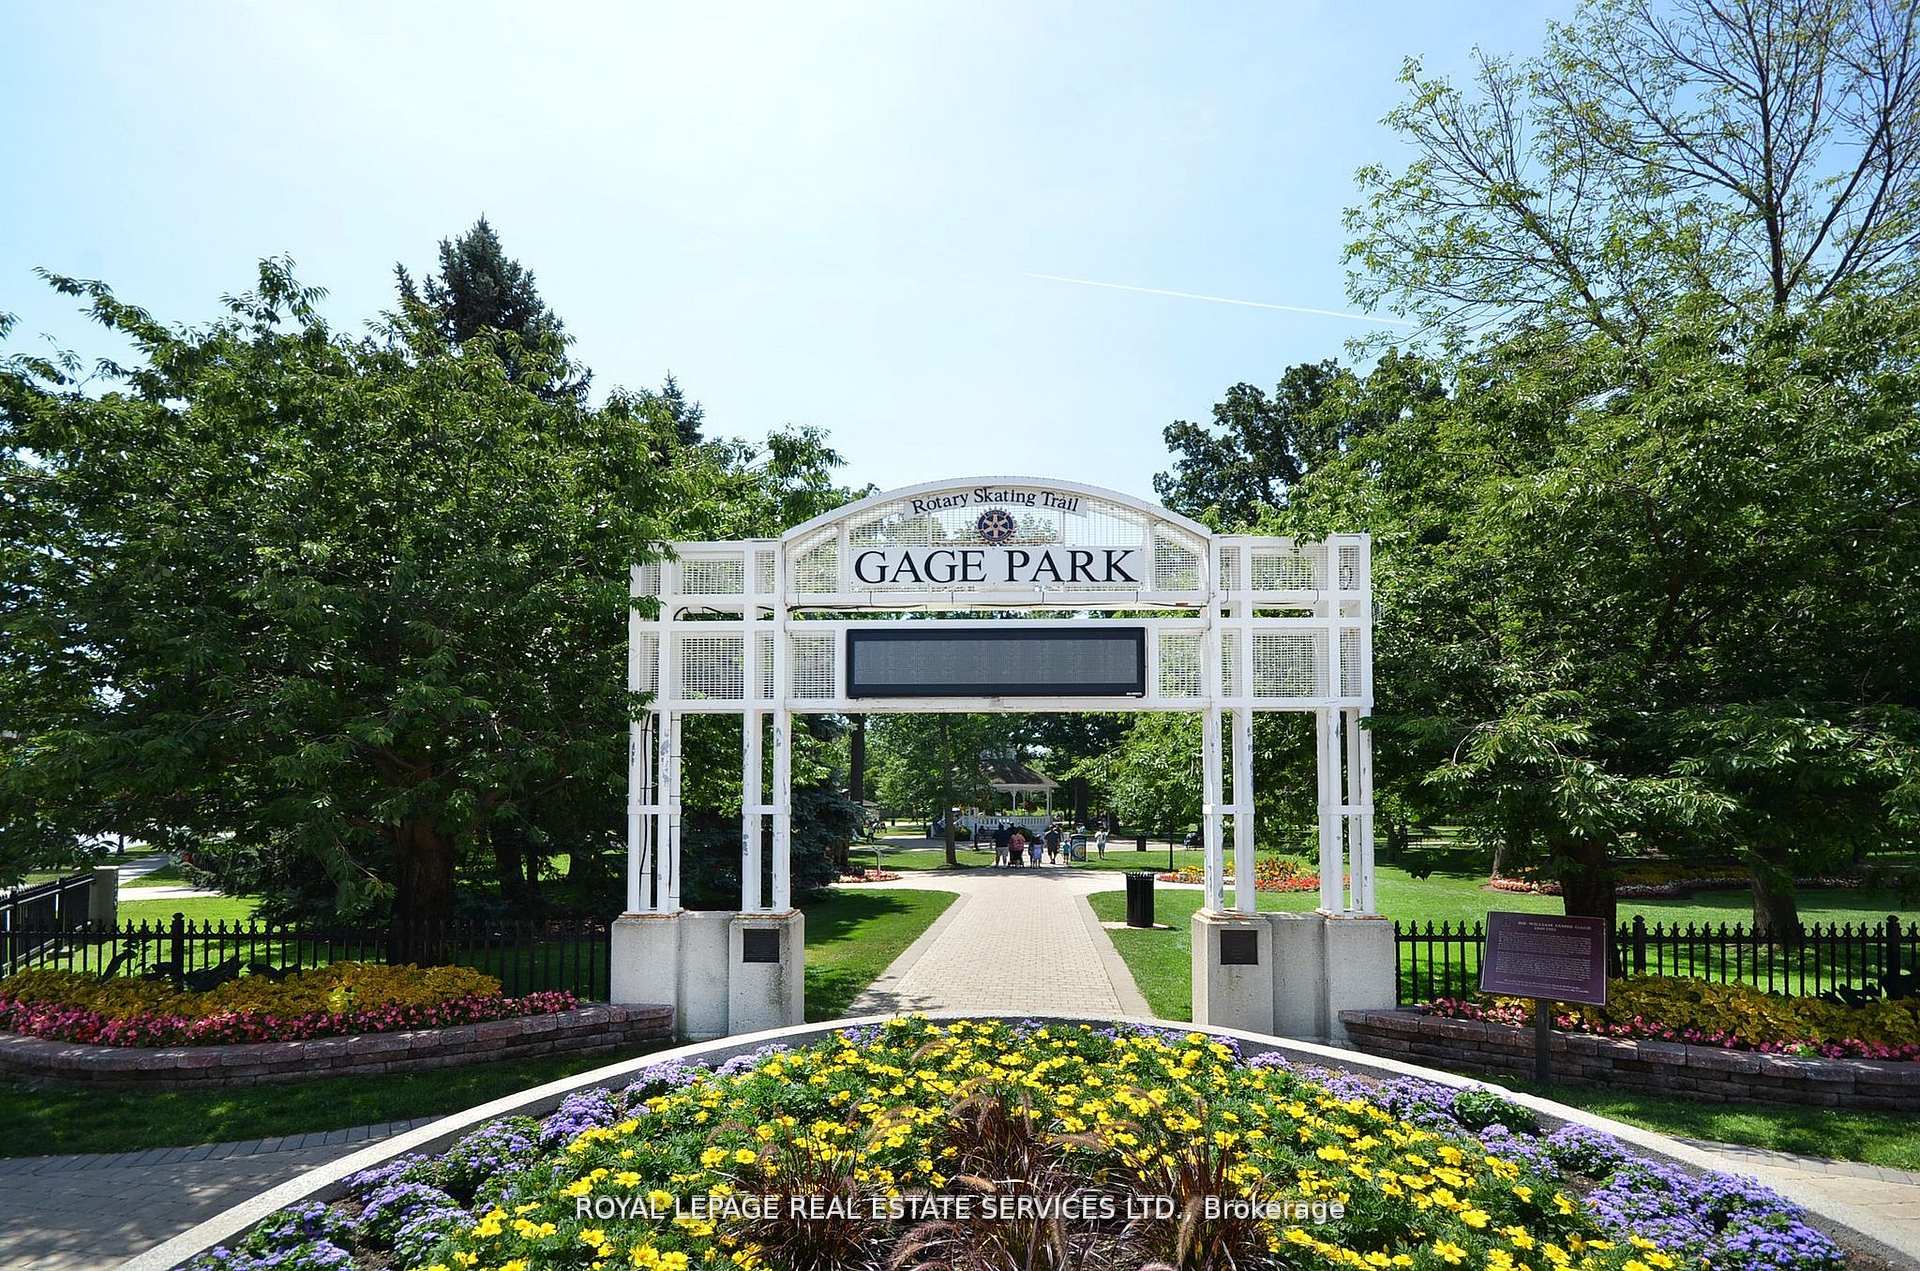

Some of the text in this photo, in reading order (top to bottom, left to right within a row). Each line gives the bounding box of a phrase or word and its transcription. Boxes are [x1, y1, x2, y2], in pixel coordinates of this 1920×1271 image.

[911, 488, 1079, 514] Rotary Skating Trail
[854, 550, 1139, 584] GAGE PARK
